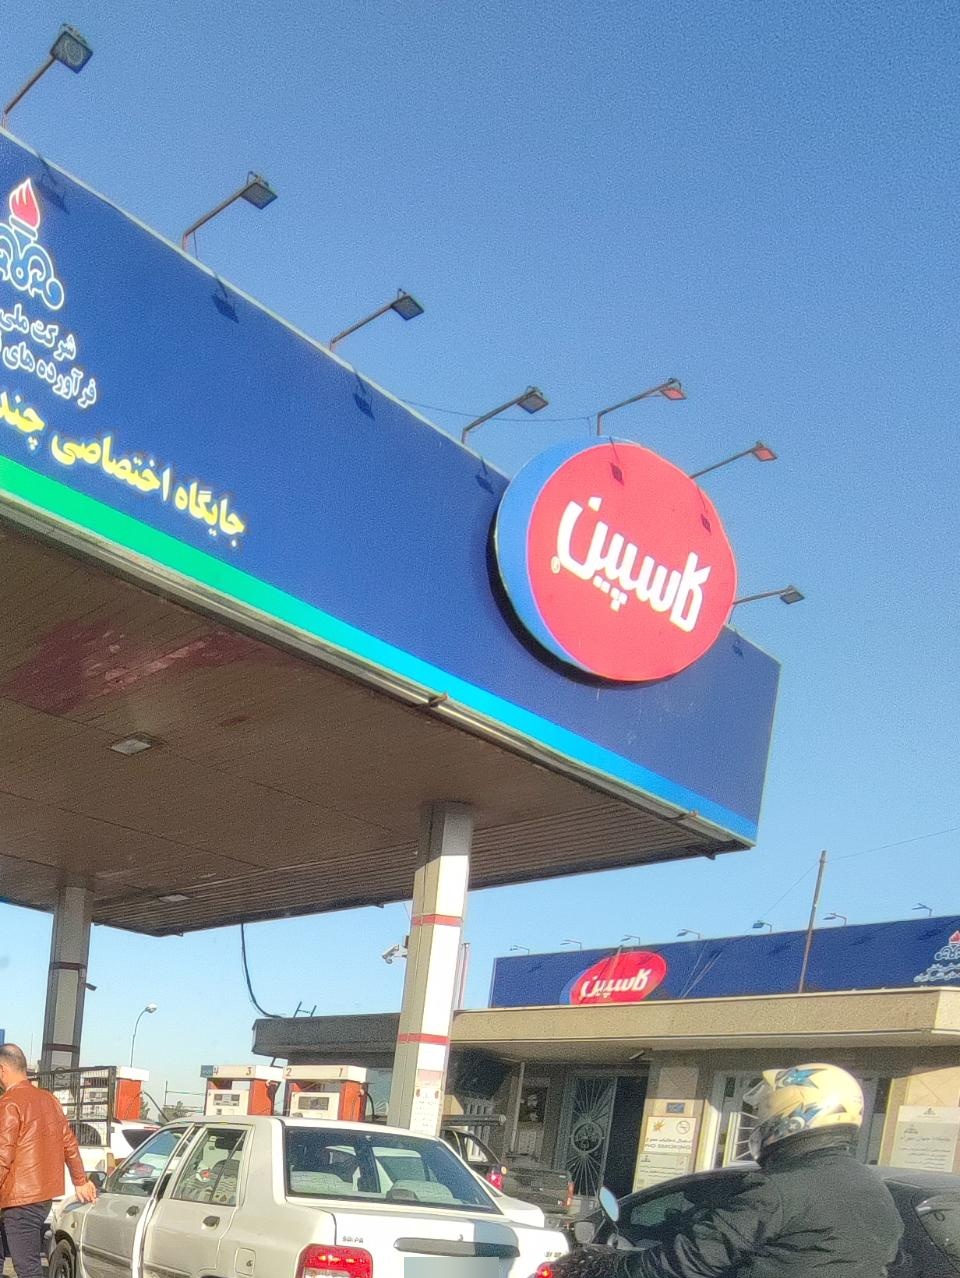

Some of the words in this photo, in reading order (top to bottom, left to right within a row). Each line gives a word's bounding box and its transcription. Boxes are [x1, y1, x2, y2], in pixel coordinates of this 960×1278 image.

[2, 341, 36, 373] های
[30, 320, 77, 361] شرکت
[36, 359, 97, 408] فرآورده
[50, 435, 171, 501] اختصاصی
[174, 482, 245, 547] جایگاه
[555, 496, 712, 633] کاسپین
[578, 968, 653, 1000] کاسپین
